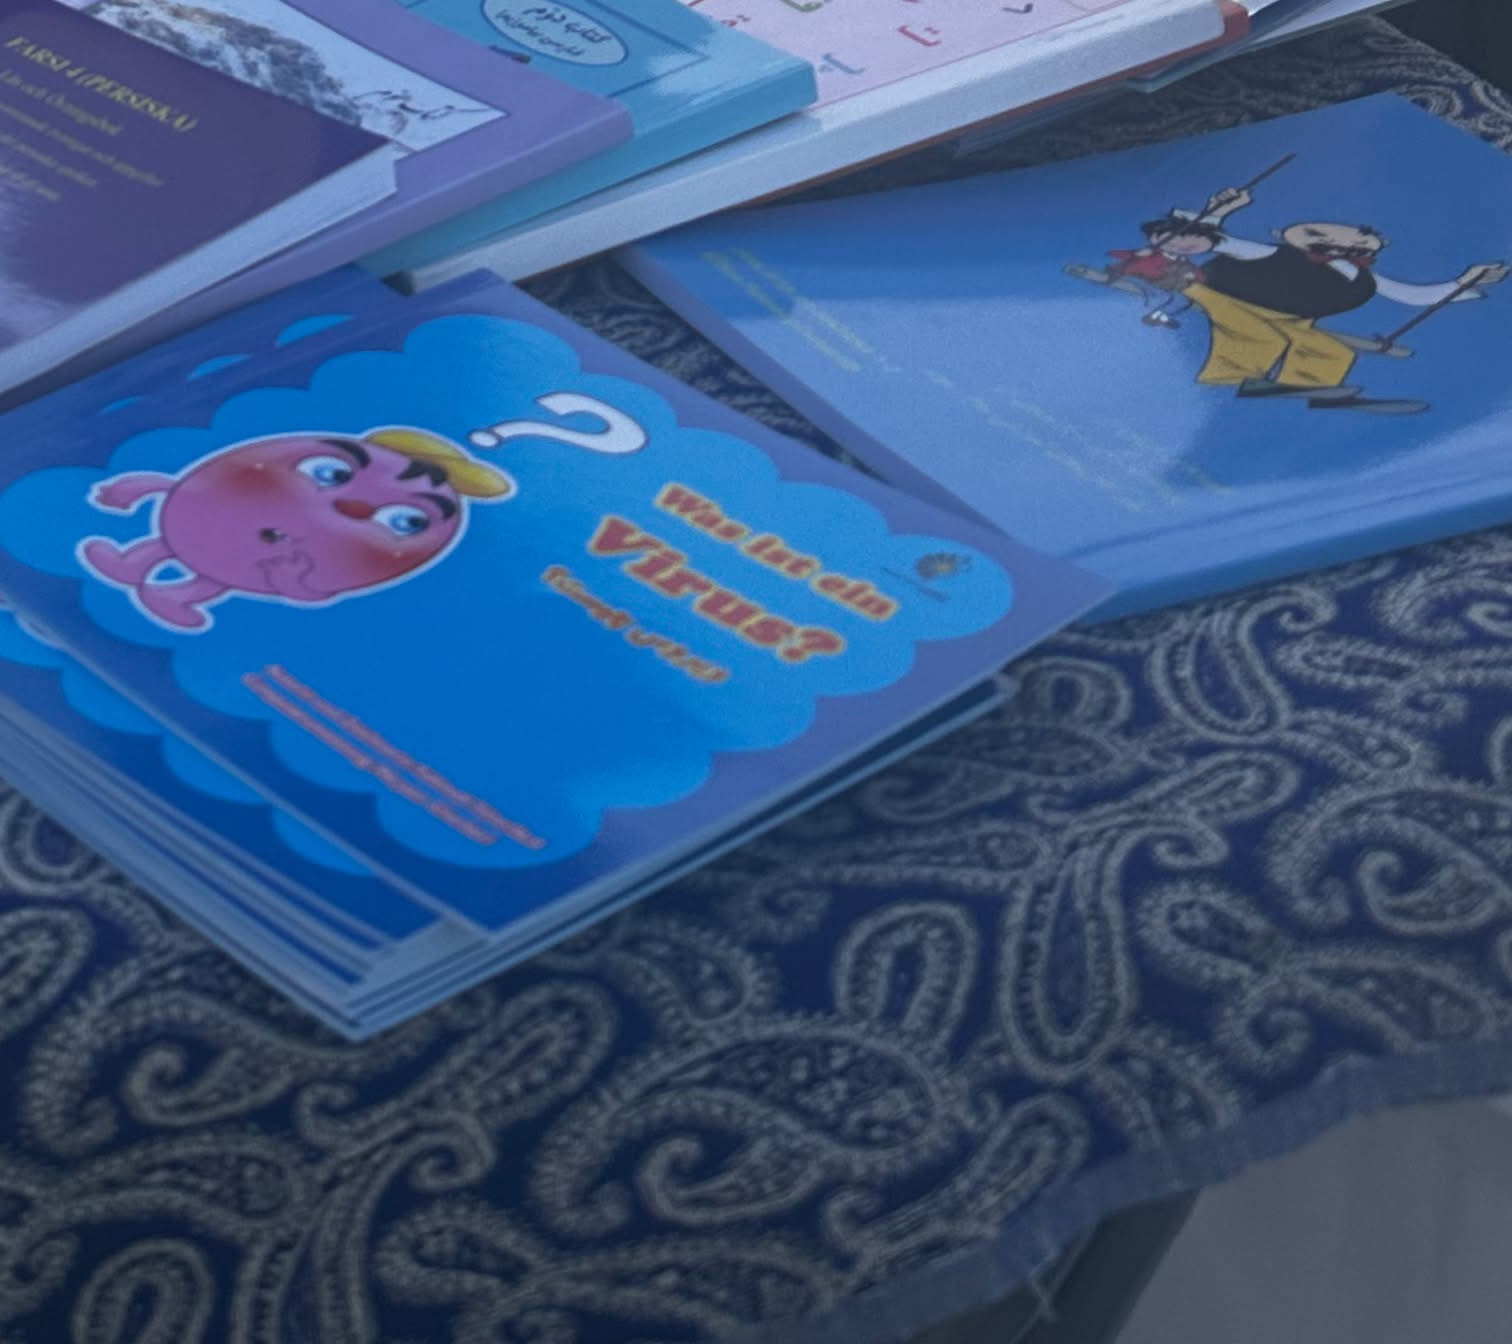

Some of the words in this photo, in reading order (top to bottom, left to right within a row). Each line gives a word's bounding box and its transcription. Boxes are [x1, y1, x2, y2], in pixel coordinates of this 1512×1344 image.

[589, 514, 846, 664] Virus?
[654, 482, 751, 543] Was
[810, 572, 899, 621] ein
